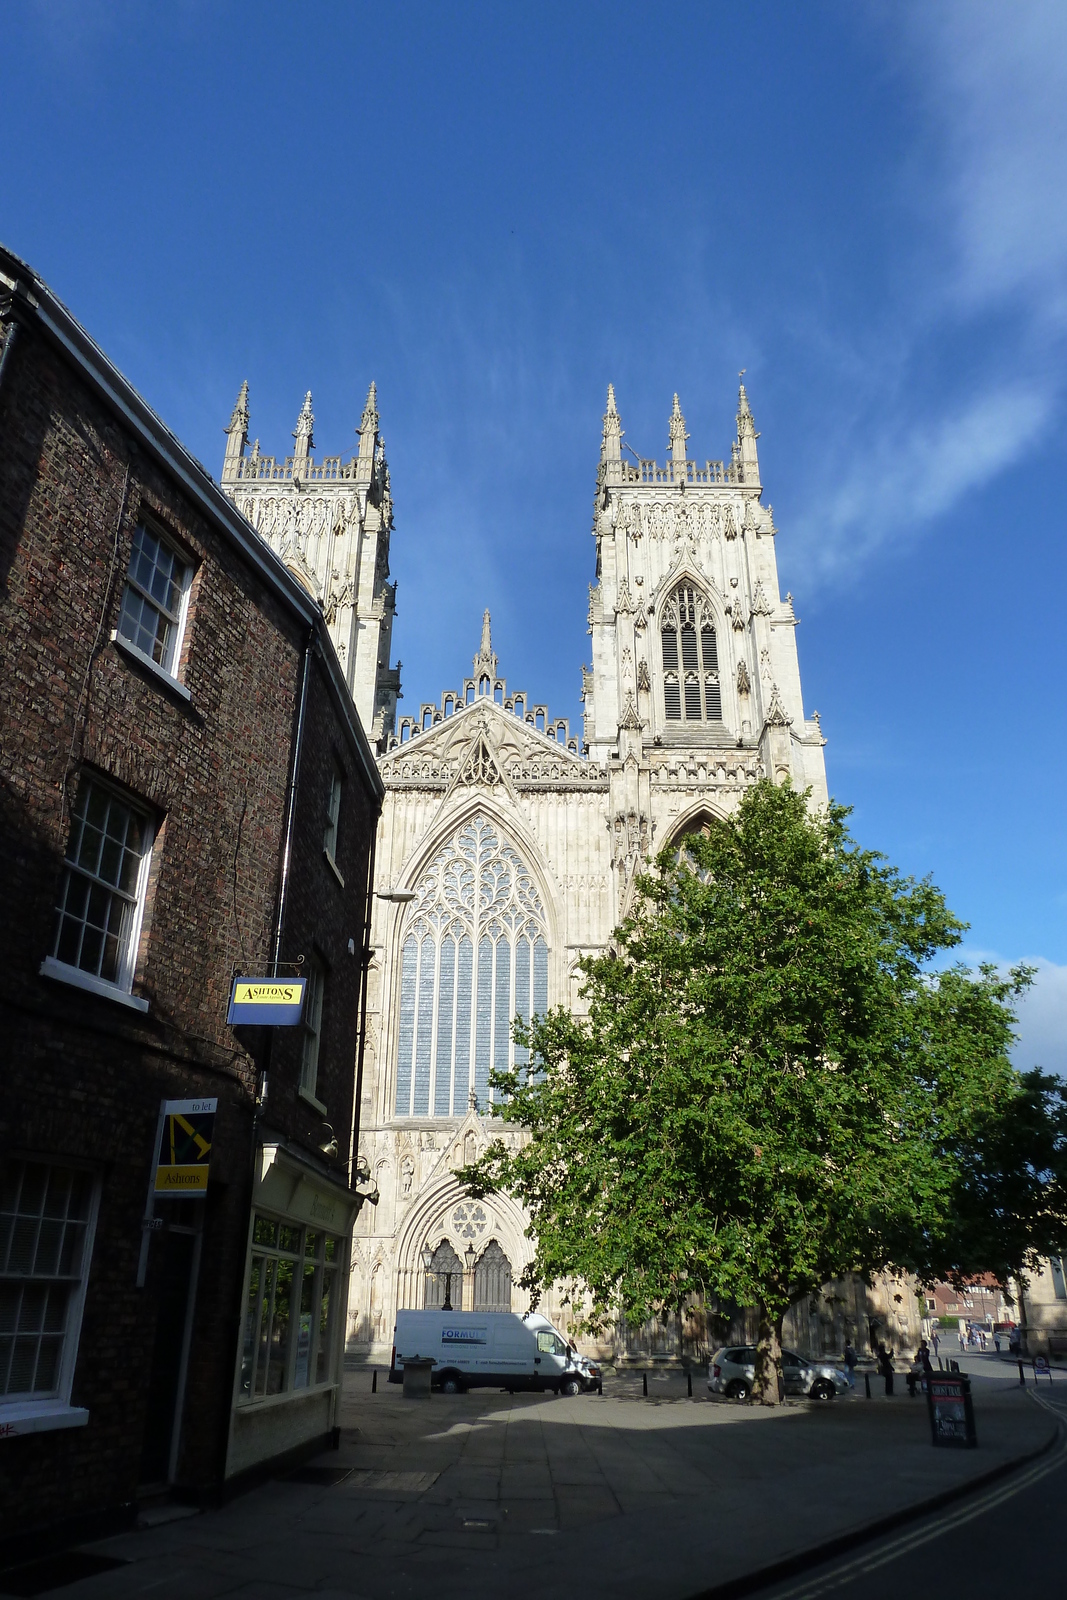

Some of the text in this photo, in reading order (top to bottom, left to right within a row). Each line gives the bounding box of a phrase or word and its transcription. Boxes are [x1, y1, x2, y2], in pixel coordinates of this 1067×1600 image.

[242, 987, 294, 1001] ASHTONS
[192, 1102, 212, 1111] to let
[164, 1172, 200, 1184] Ashtons
[442, 1330, 486, 1338] FORMULA
